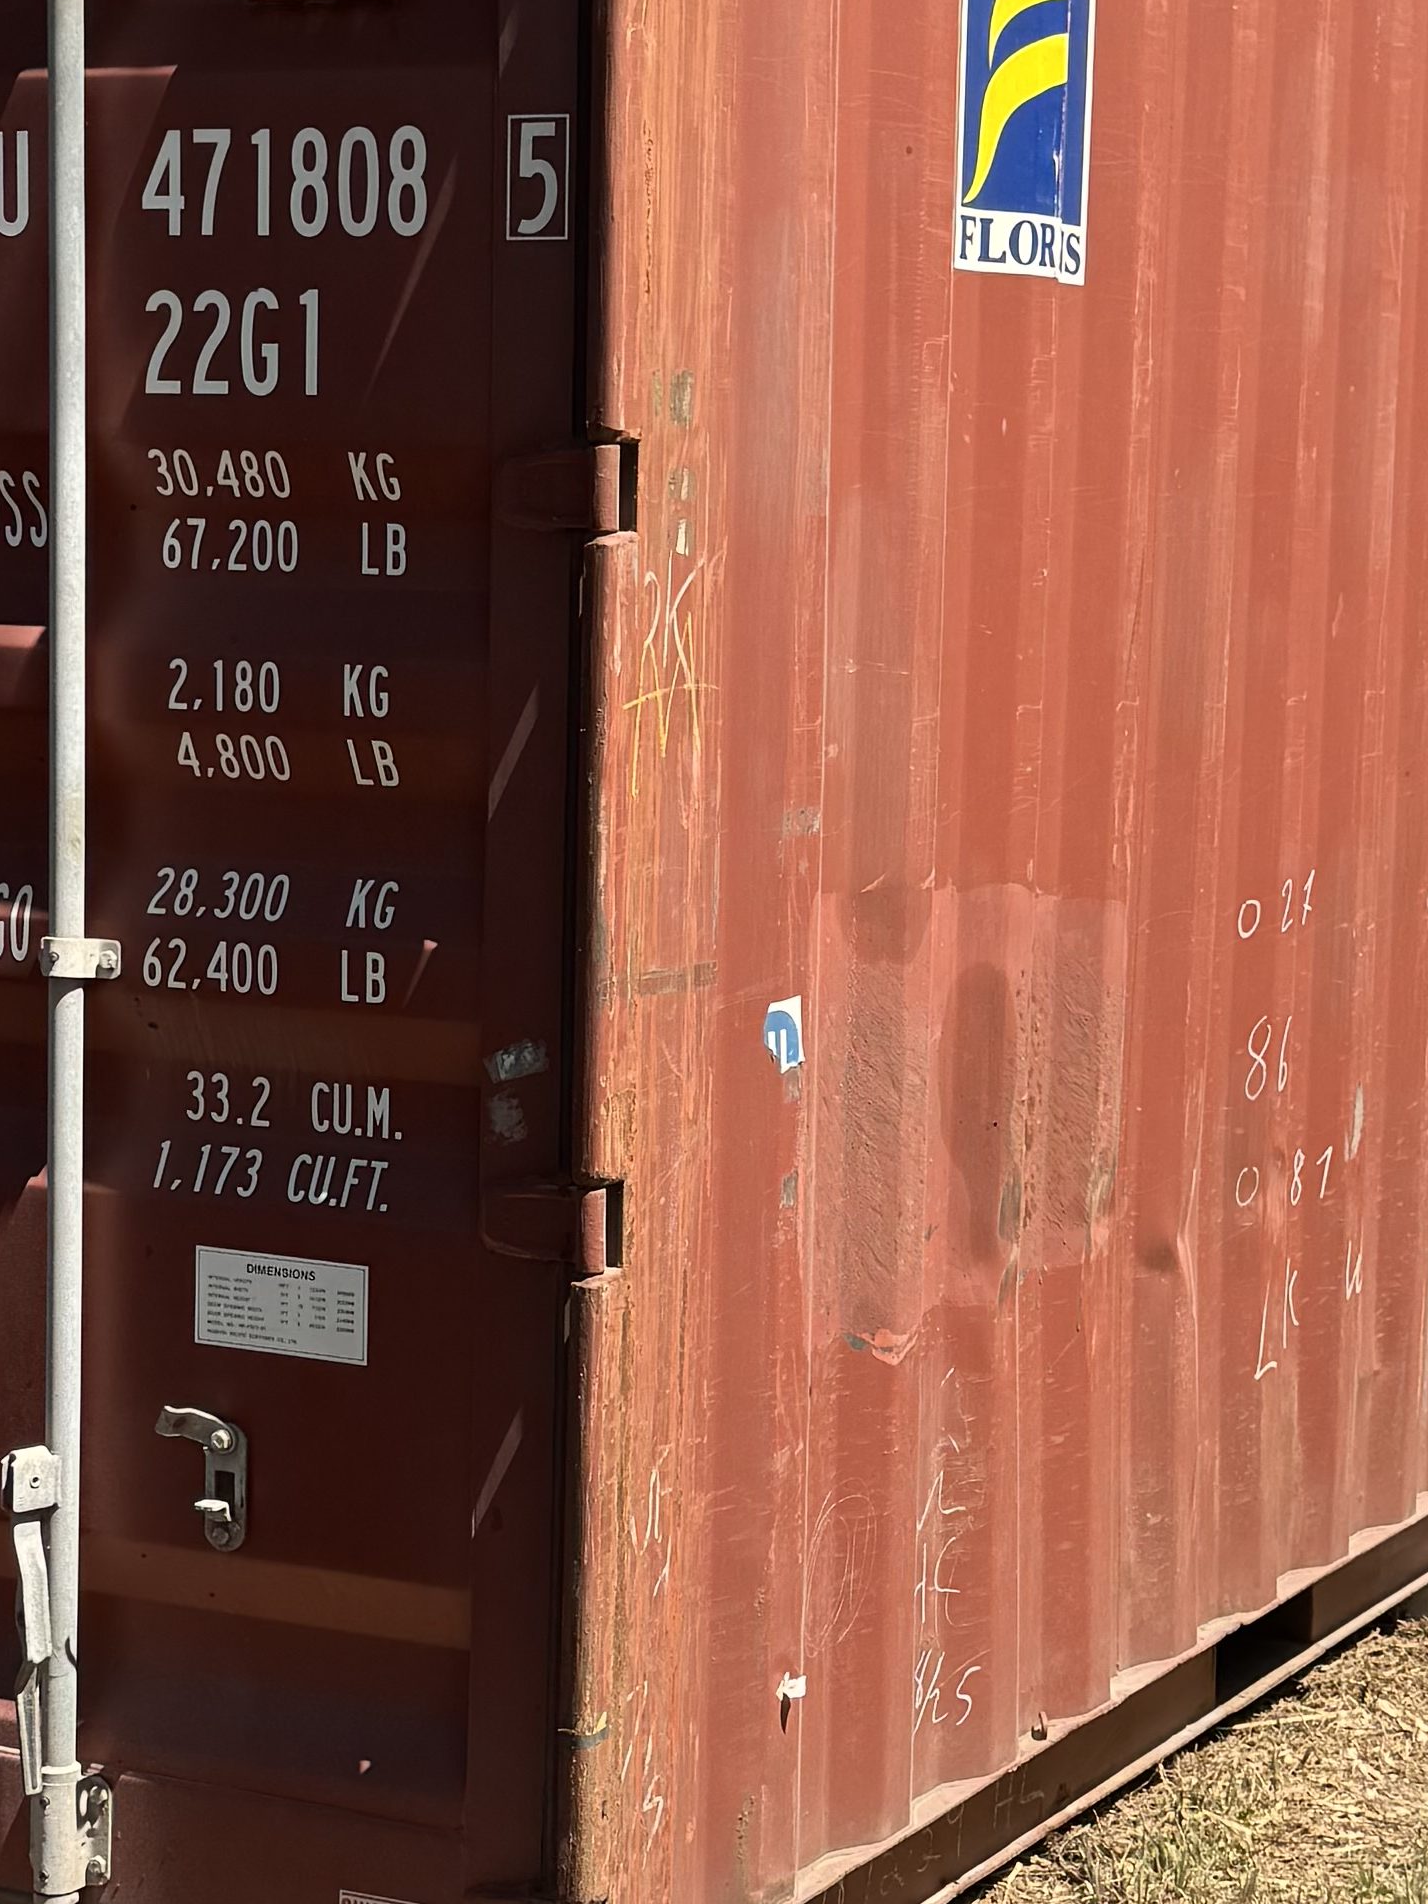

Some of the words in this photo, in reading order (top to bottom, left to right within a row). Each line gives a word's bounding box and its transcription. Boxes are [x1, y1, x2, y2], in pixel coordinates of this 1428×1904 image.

[141, 125, 428, 238] 471808
[517, 121, 558, 235] 5
[144, 287, 319, 397] 22G1
[147, 448, 291, 499] 30,480
[347, 451, 401, 501] KG
[162, 517, 298, 573] 67,200
[361, 522, 407, 576] LB
[168, 658, 280, 713] 2,180
[343, 663, 389, 718] KG
[177, 731, 291, 781] 4,800
[346, 738, 400, 787] LB
[146, 866, 290, 922] 28,300
[345, 878, 399, 930] KG
[142, 937, 278, 995] 62,400
[341, 949, 386, 1004] LB
[186, 1070, 271, 1128] 33.2
[311, 1082, 403, 1141] CU.M.
[153, 1140, 263, 1198] 1,173
[287, 1153, 389, 1212] CU.FT.
[246, 1263, 316, 1281] DIMENSIONS
